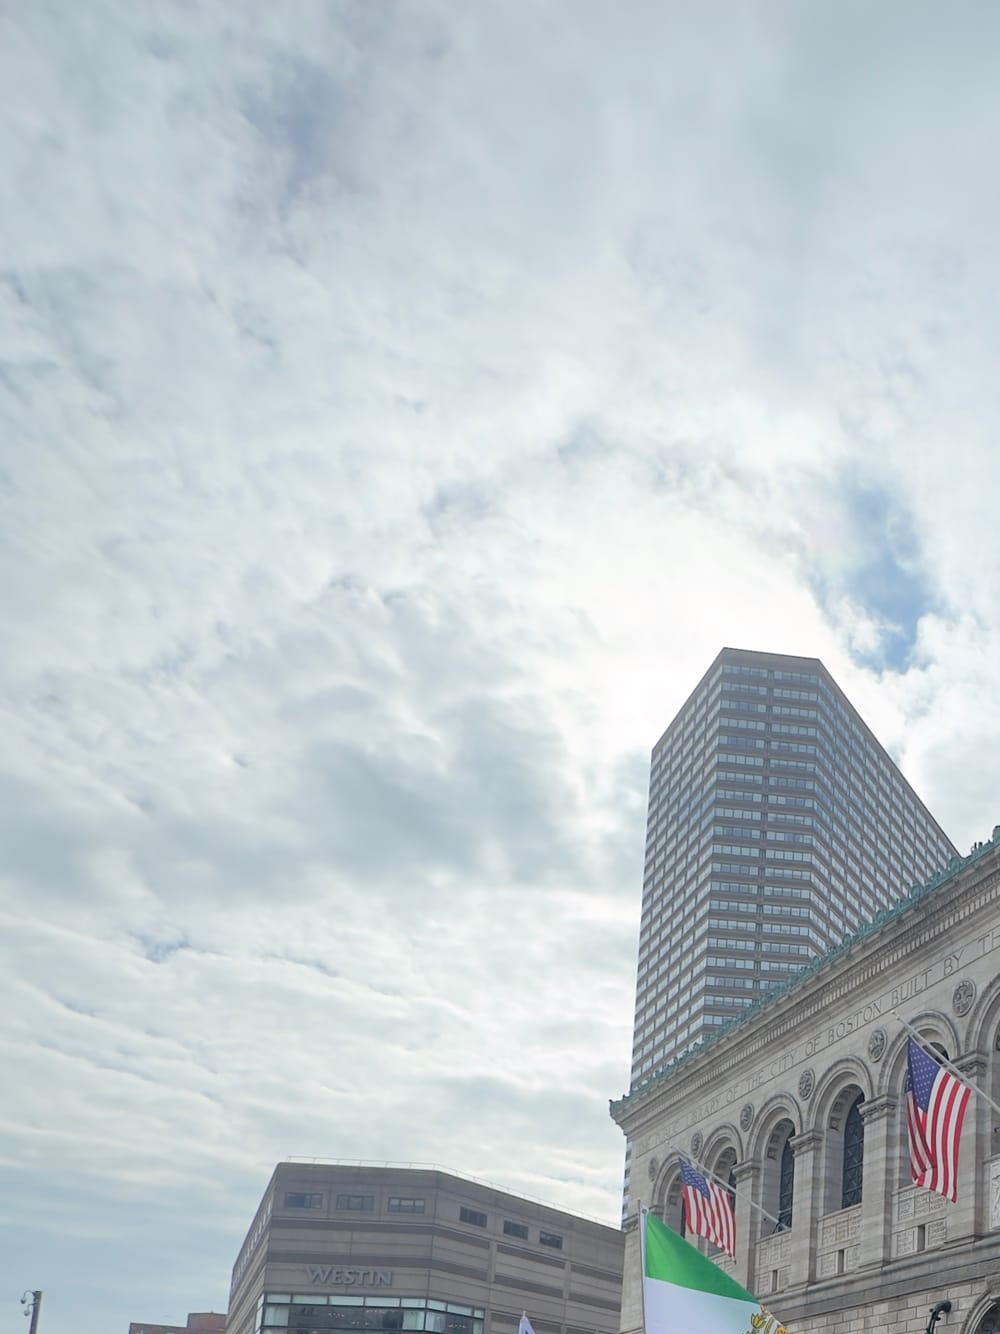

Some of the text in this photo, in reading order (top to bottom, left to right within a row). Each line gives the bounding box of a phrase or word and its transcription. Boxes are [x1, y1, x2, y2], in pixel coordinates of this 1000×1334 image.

[726, 1083, 740, 1102] OF
[746, 1069, 763, 1093] THE
[770, 1051, 795, 1078] CITY
[804, 1036, 821, 1057] OF
[827, 999, 882, 1043] BOSTON
[891, 968, 933, 1008] BUILT
[943, 949, 965, 978] BY
[306, 1265, 393, 1287] WESTIN
